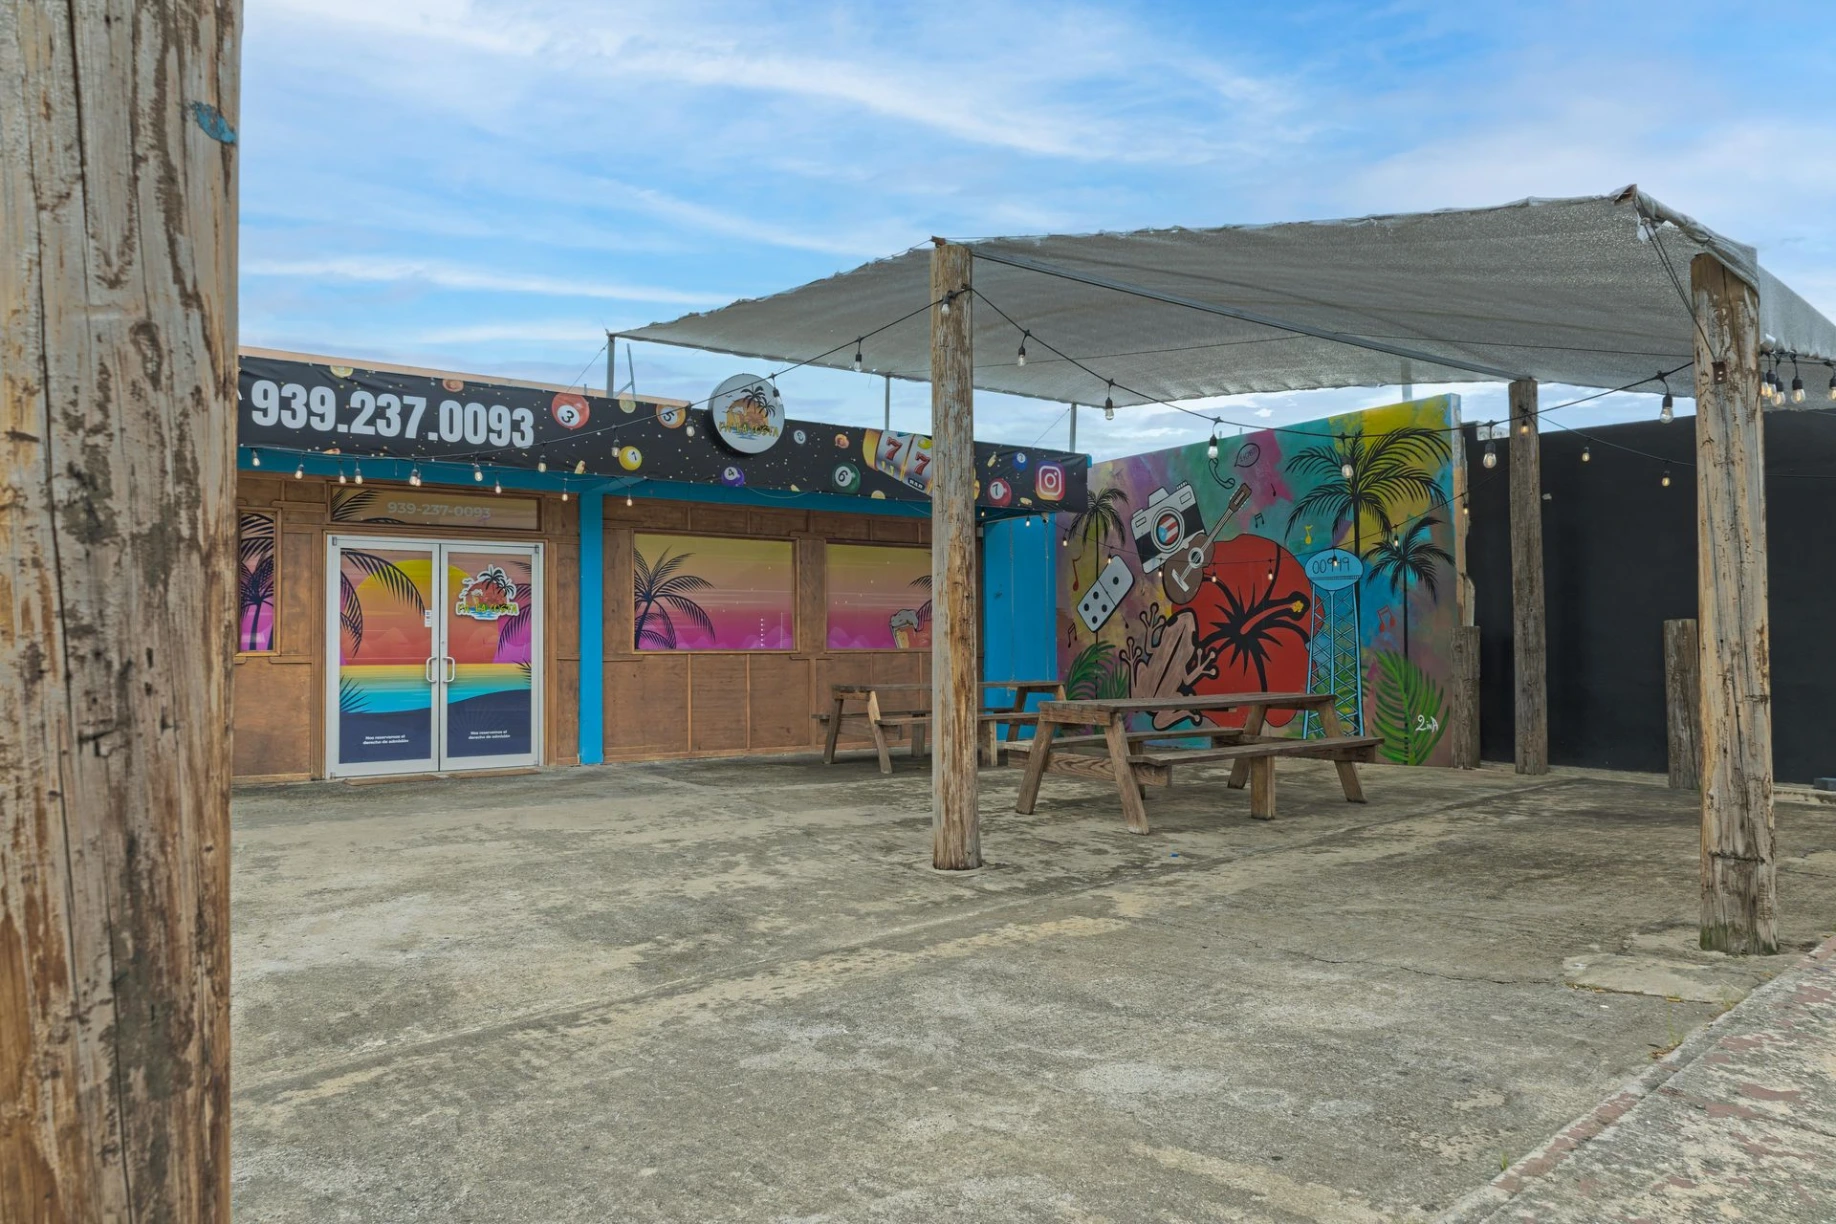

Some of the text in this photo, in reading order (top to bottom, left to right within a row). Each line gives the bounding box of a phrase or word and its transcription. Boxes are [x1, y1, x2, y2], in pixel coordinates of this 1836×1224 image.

[251, 379, 534, 449] 939.237.0093
[561, 410, 575, 423] 3
[663, 411, 675, 422] 5
[886, 436, 931, 476] 7 7
[728, 468, 735, 477] 4
[837, 469, 849, 482] 6
[387, 502, 491, 518] 939-237-0093
